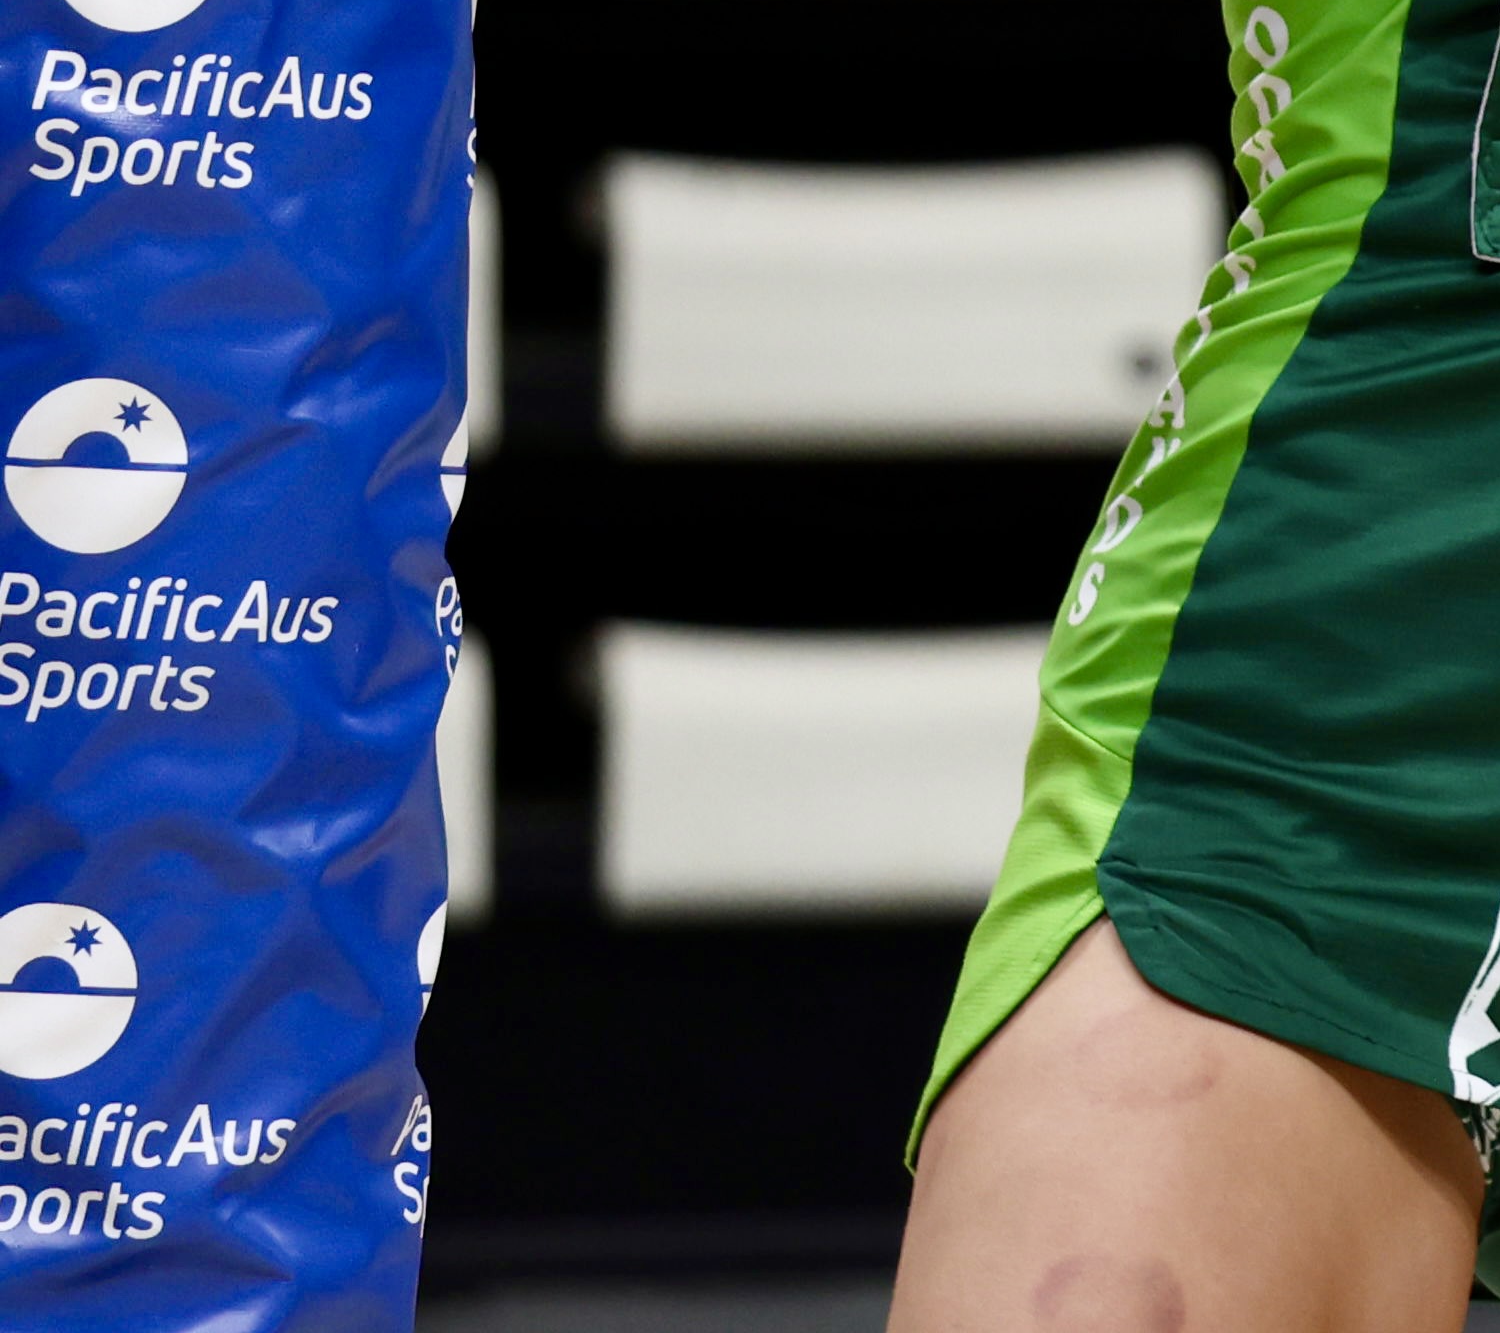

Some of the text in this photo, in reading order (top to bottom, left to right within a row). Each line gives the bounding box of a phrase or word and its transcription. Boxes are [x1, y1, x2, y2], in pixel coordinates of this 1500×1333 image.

[32, 50, 372, 120] PacificAus
[29, 118, 254, 197] Sports
[0, 572, 339, 643] PacificAus
[0, 643, 215, 722] Sports
[0, 1103, 296, 1168] acificAus
[0, 1182, 165, 1239] ports
